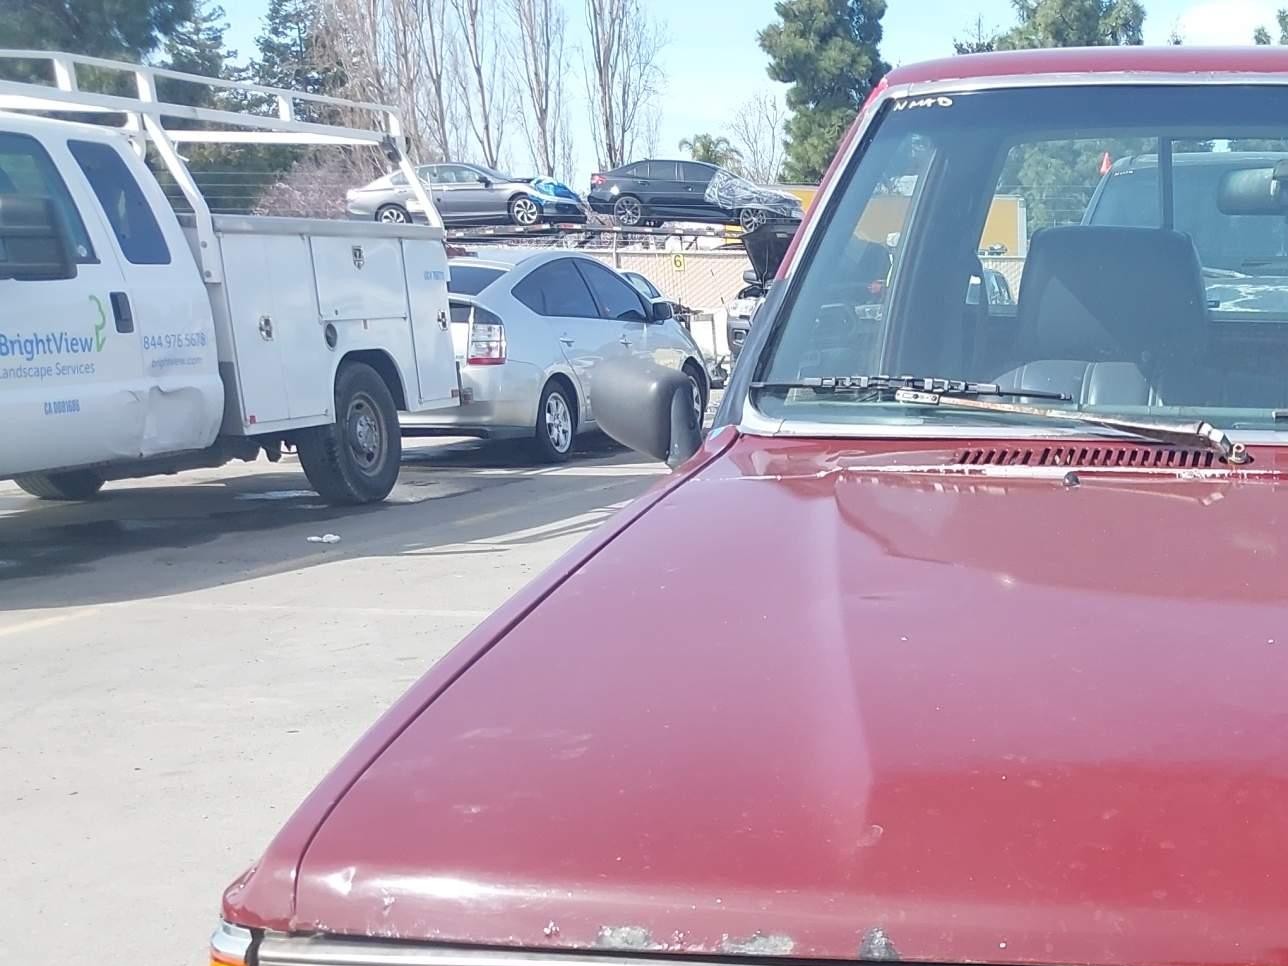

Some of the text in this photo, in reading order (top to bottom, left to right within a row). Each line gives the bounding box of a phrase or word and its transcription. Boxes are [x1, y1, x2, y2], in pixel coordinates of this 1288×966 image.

[673, 254, 682, 268] 6
[0, 331, 94, 362] BrightView
[143, 335, 163, 350] 844
[55, 362, 96, 376] Services
